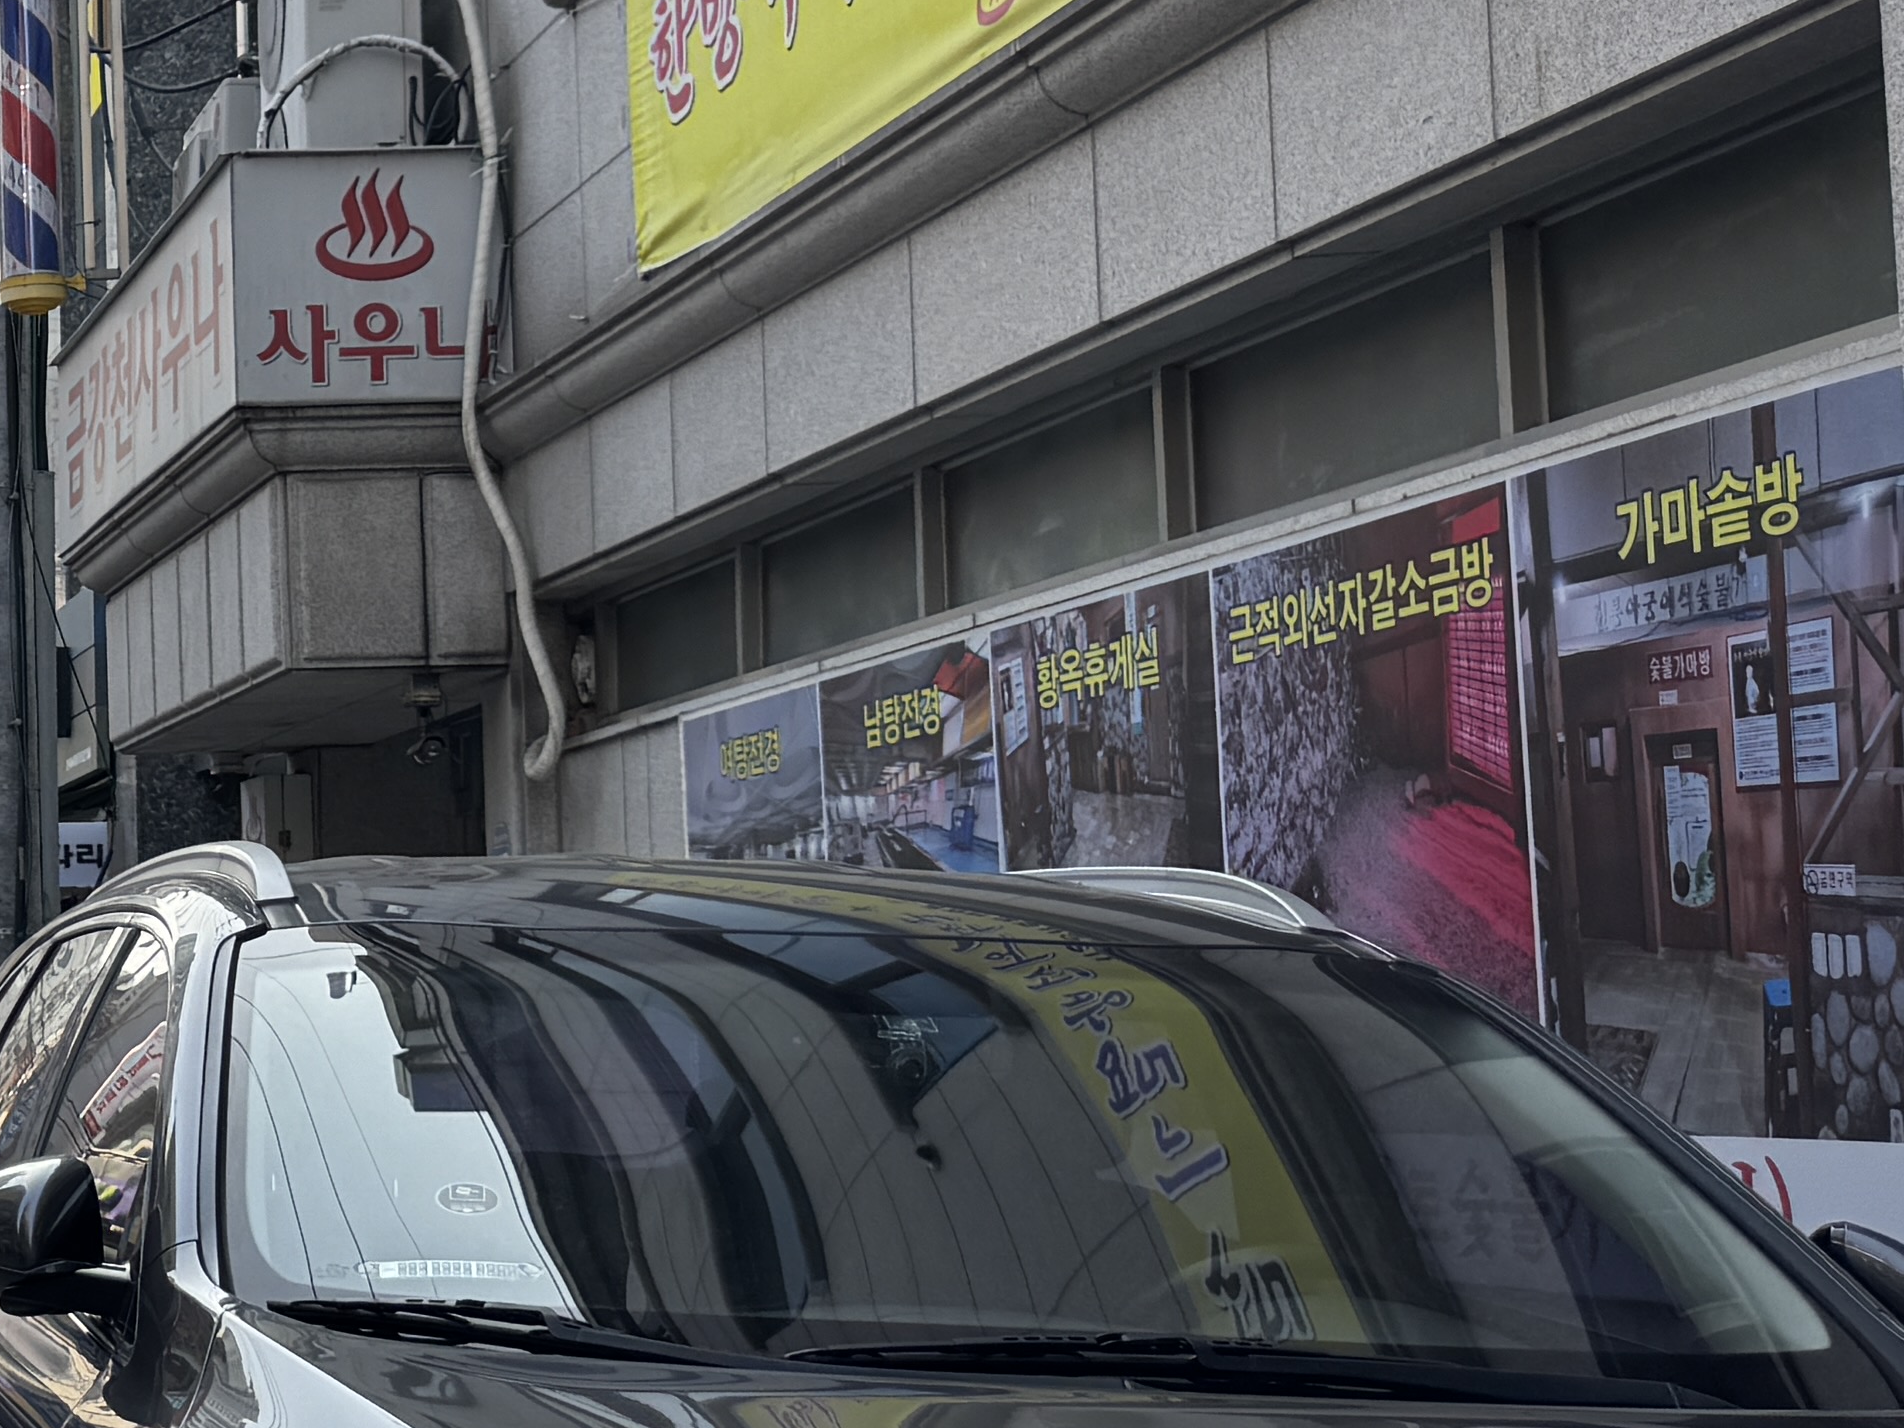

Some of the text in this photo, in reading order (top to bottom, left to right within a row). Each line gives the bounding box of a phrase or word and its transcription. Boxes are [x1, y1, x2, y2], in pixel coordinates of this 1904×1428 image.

[256, 302, 497, 387] 사우나
[1616, 452, 1806, 565] 가마솥방
[1227, 536, 1496, 667] 근적외선자갈소금방
[1037, 625, 1161, 711] 황옥휴게실
[719, 725, 782, 782] 여탕전경
[863, 683, 942, 749] 남탕전경
